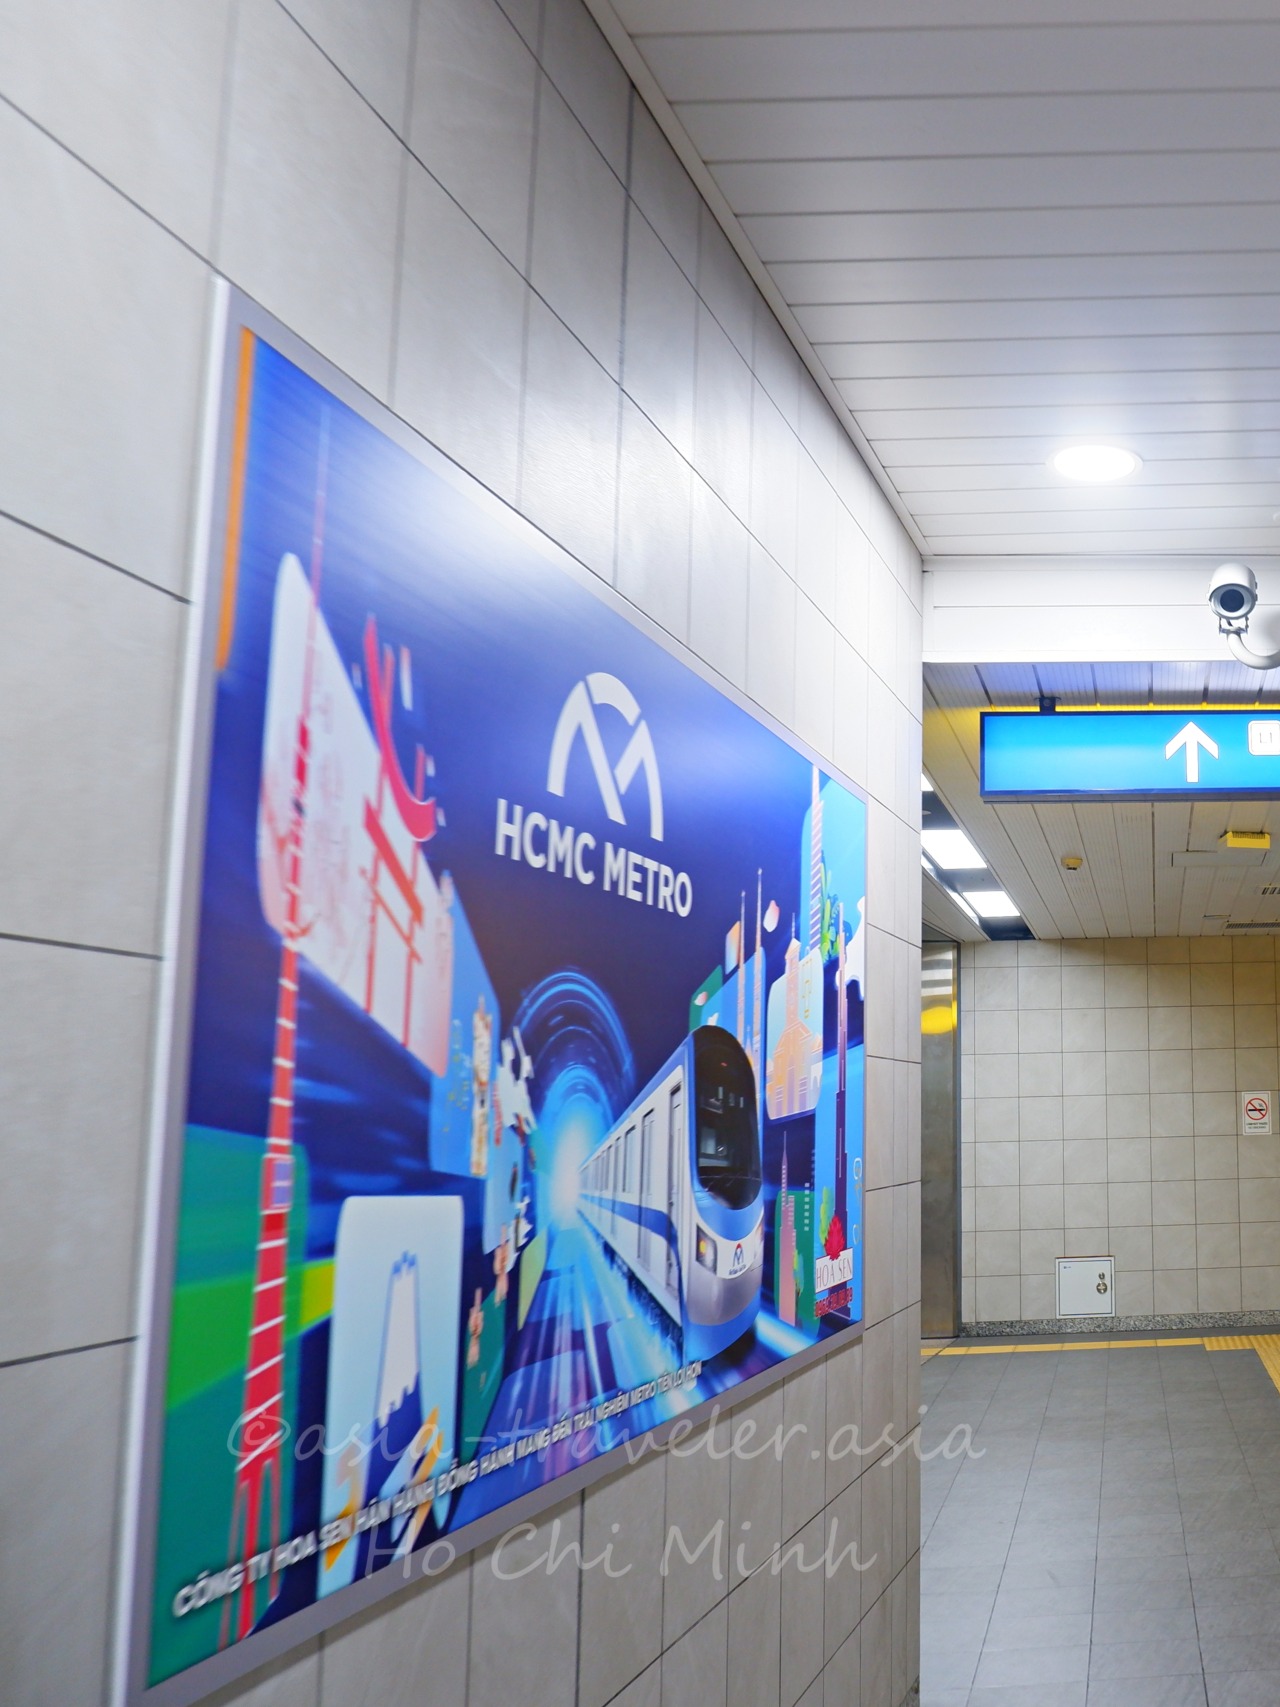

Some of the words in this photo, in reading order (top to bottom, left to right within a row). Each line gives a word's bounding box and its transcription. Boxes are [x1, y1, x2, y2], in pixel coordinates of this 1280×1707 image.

[495, 797, 597, 885] HCMC
[602, 841, 693, 918] METRO
[816, 1262, 836, 1289] HOA
[173, 1563, 244, 1618] CÔNG
[272, 1530, 318, 1573] HOA
[515, 1427, 551, 1460] MANG
[628, 1383, 656, 1407] METRO
